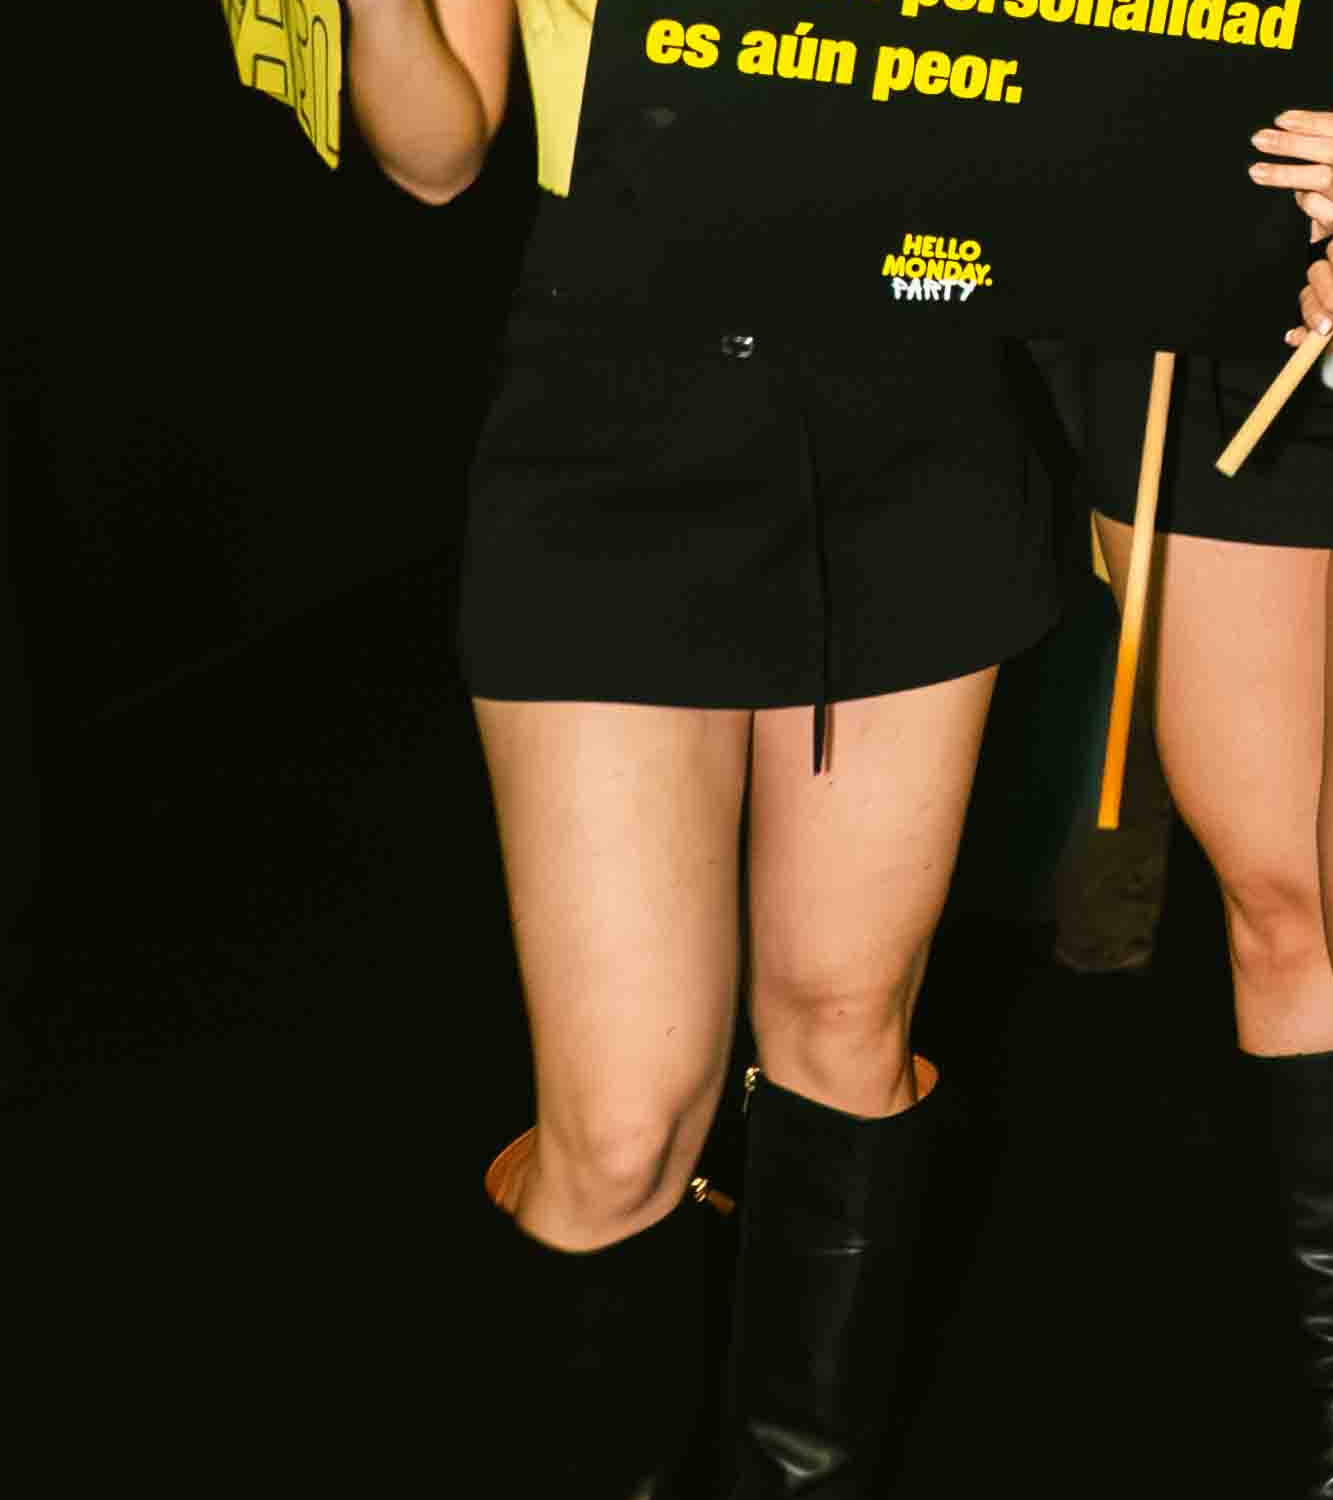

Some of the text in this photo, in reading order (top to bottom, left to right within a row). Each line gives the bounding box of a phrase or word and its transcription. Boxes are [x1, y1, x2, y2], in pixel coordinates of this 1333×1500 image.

[645, 18, 1023, 105] es aún peor.
[902, 233, 982, 262] HELLO
[881, 254, 993, 287] MONDAY.
[890, 277, 977, 302] PARTY
